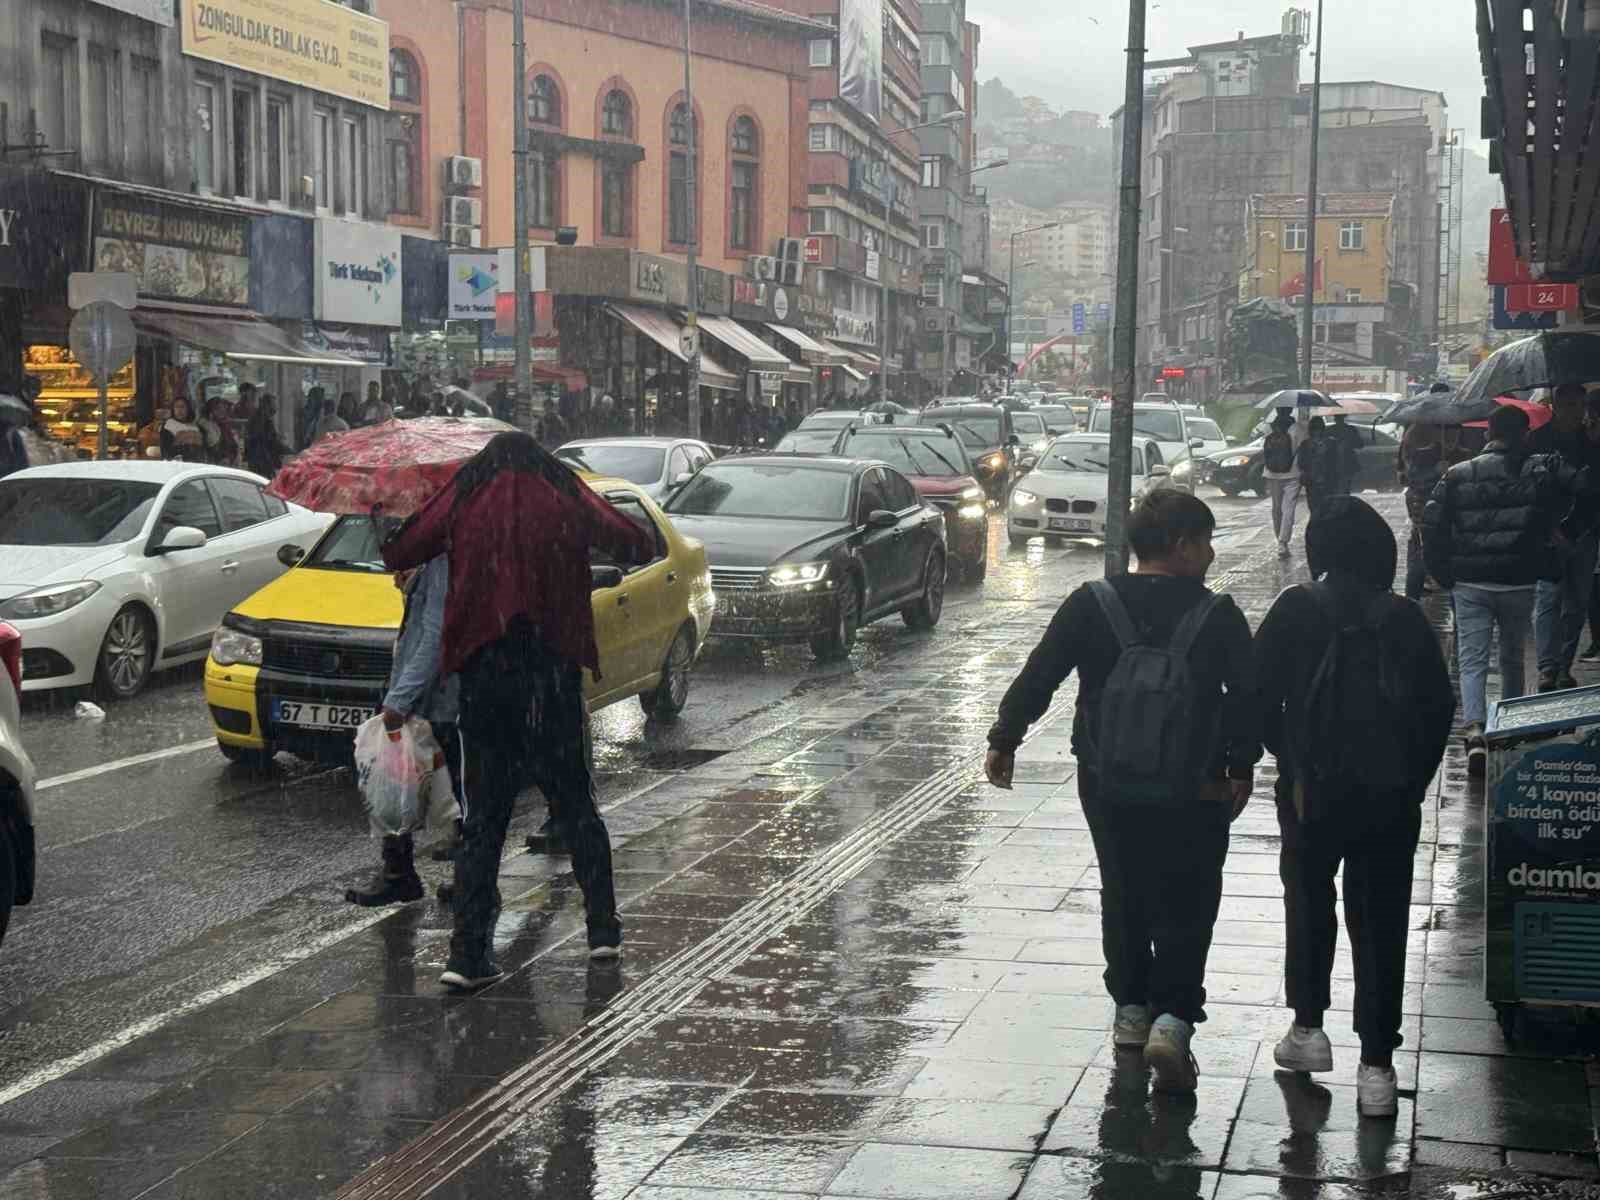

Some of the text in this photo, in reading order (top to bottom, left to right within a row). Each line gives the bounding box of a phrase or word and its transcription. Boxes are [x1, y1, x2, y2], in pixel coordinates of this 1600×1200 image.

[198, 3, 271, 47] ZONGULDAK
[273, 27, 312, 59] EMLAK
[103, 207, 161, 238] DEVREZ
[1538, 291, 1555, 305] 24
[280, 703, 302, 722] 67
[310, 705, 321, 723] T
[1517, 771, 1531, 782] bir
[1535, 771, 1571, 783] damla
[1507, 803, 1563, 820] birden
[1538, 822, 1558, 839] ilk
[1507, 862, 1600, 890] damla
